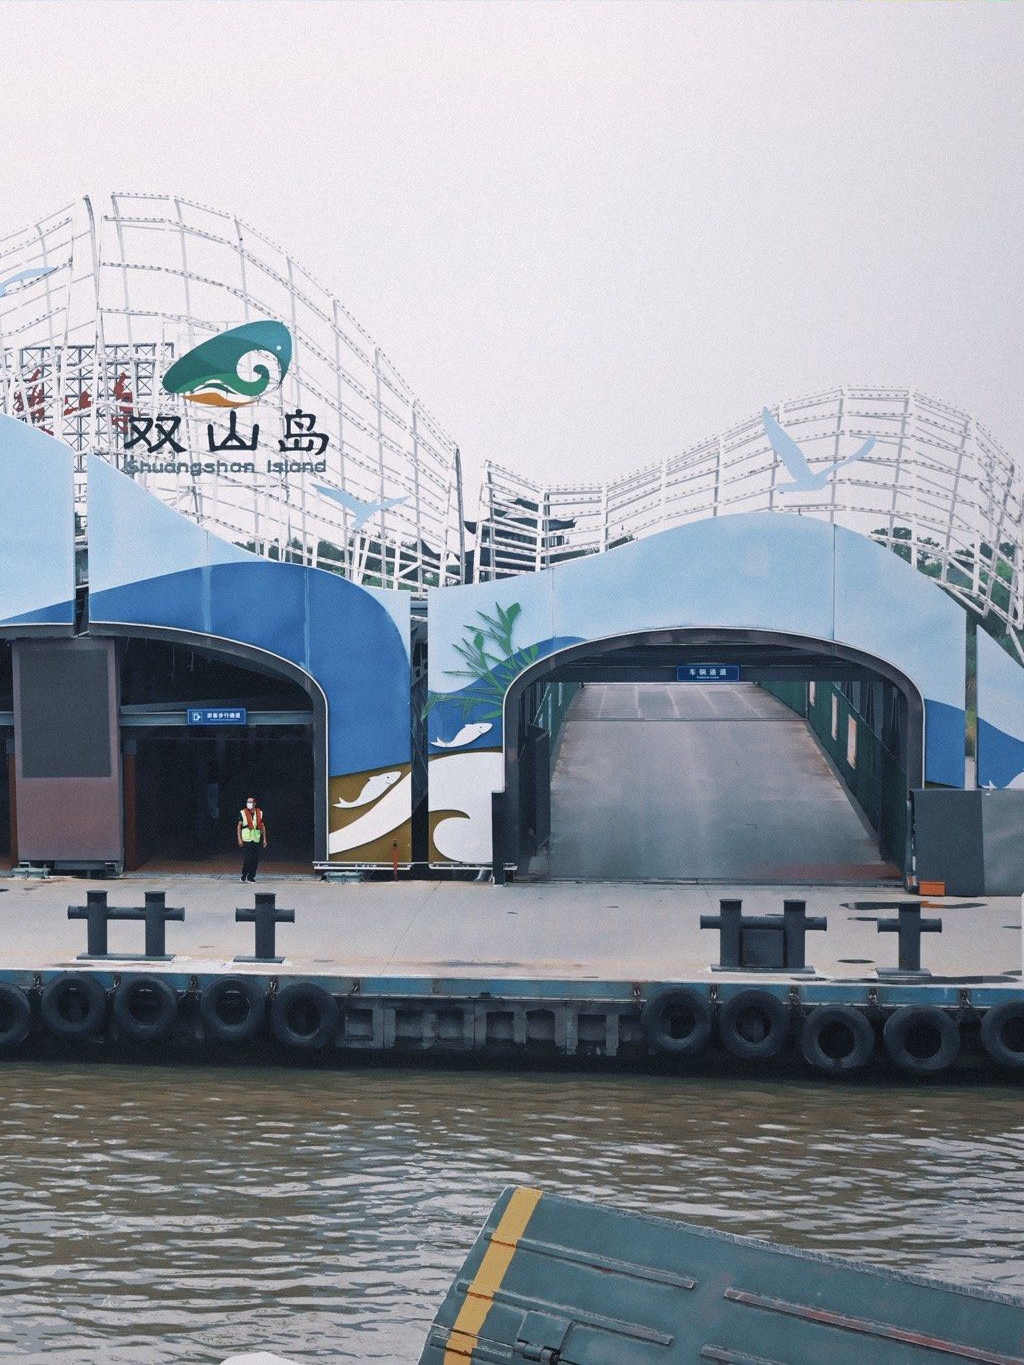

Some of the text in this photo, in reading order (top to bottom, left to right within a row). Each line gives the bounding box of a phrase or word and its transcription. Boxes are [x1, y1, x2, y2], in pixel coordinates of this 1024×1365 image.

[123, 408, 330, 456] 双山岛
[125, 459, 327, 476] Shuangshan Island
